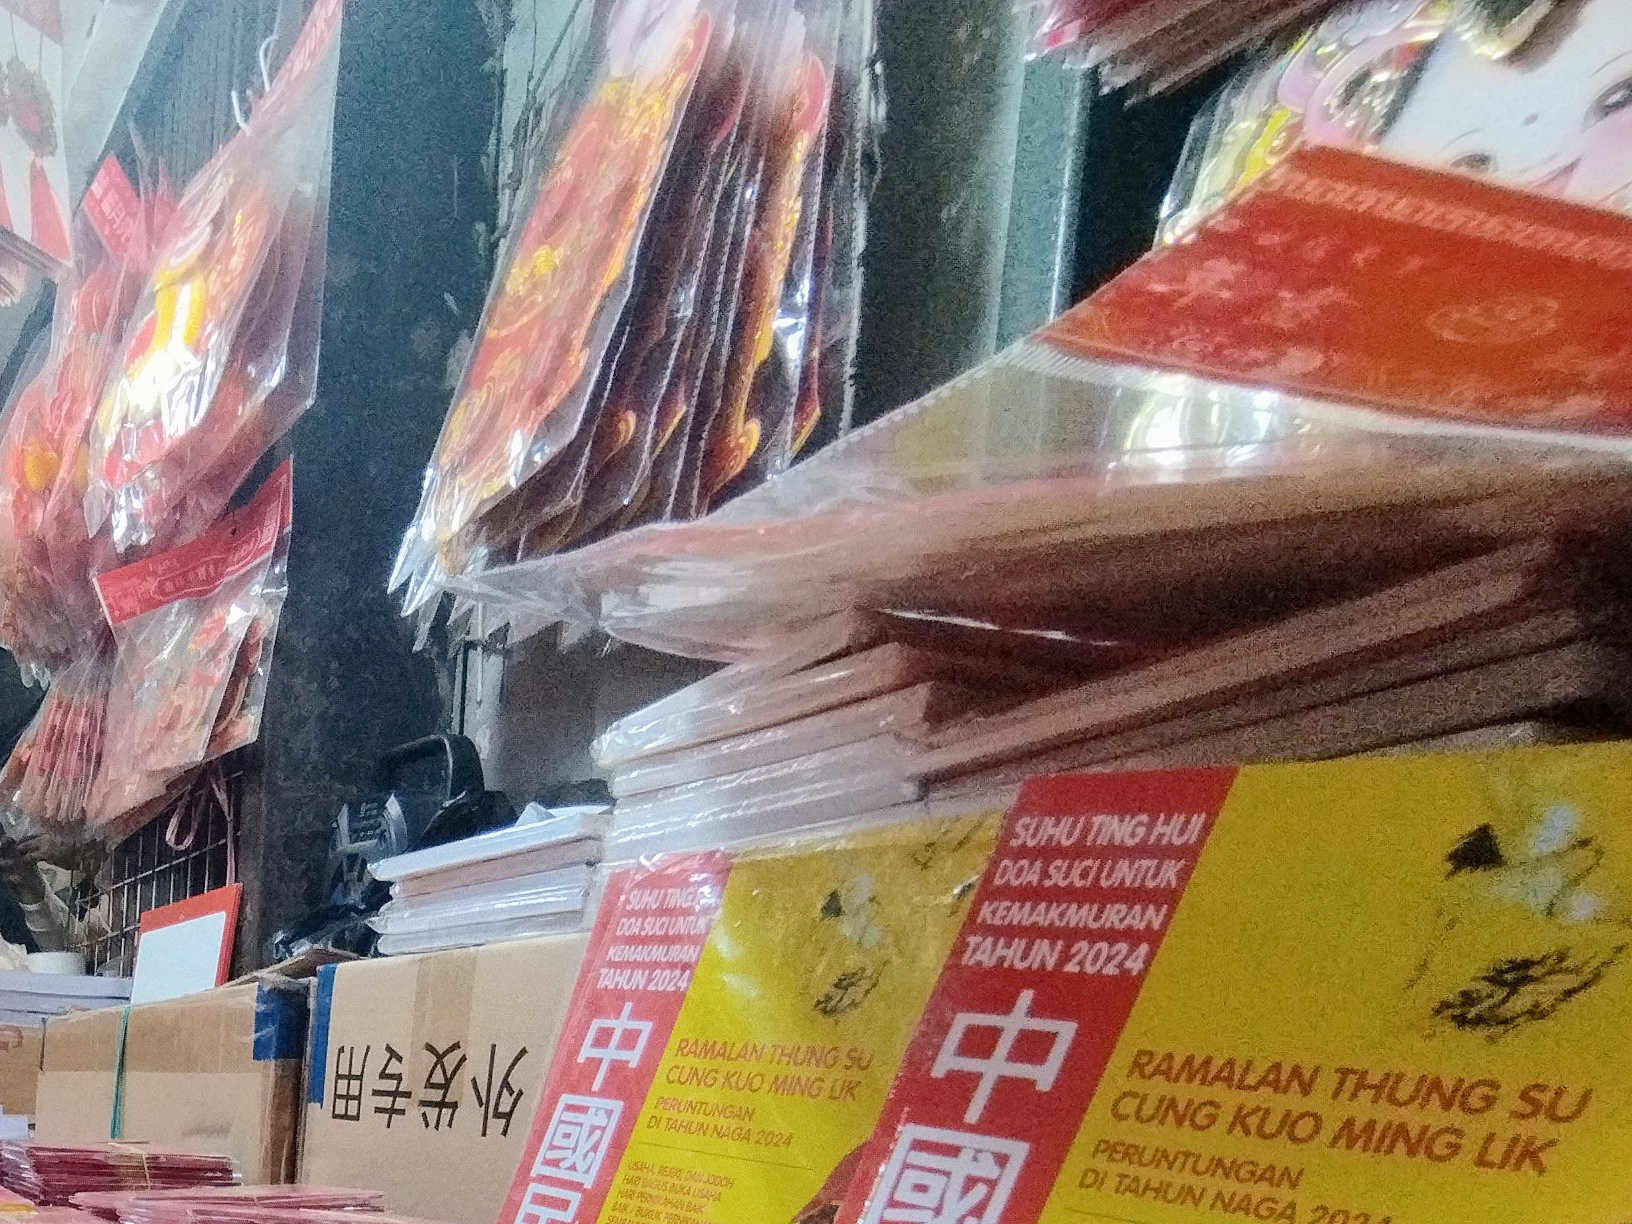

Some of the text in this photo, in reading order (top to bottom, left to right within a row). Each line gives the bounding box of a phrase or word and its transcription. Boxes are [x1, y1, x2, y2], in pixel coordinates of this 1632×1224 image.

[1010, 812, 1207, 847] SUHU TING HUI
[993, 858, 1186, 888] DOA SUCI UNTUK
[976, 901, 1168, 931] KEMAKMURAN
[962, 935, 1150, 976] TAHUN 2024
[597, 968, 691, 991] TAHUN 2024
[675, 1038, 873, 1071] RAMALAN THUNG SU
[332, 1041, 529, 1137] 外发专用
[666, 1064, 862, 1101] CUNG KUO MING LIK
[1127, 1049, 1593, 1124] RAMALAN THUNG SU
[655, 1096, 756, 1122] PERUNTUNGAN
[647, 1115, 793, 1148] DI TAHUN NAGA 2024
[1111, 1090, 1562, 1177] CUNG KUO MING LIK
[1093, 1138, 1304, 1191] PERUNTUNGAN
[1079, 1168, 1108, 1192] DI
[1113, 1173, 1206, 1208] TAHUN
